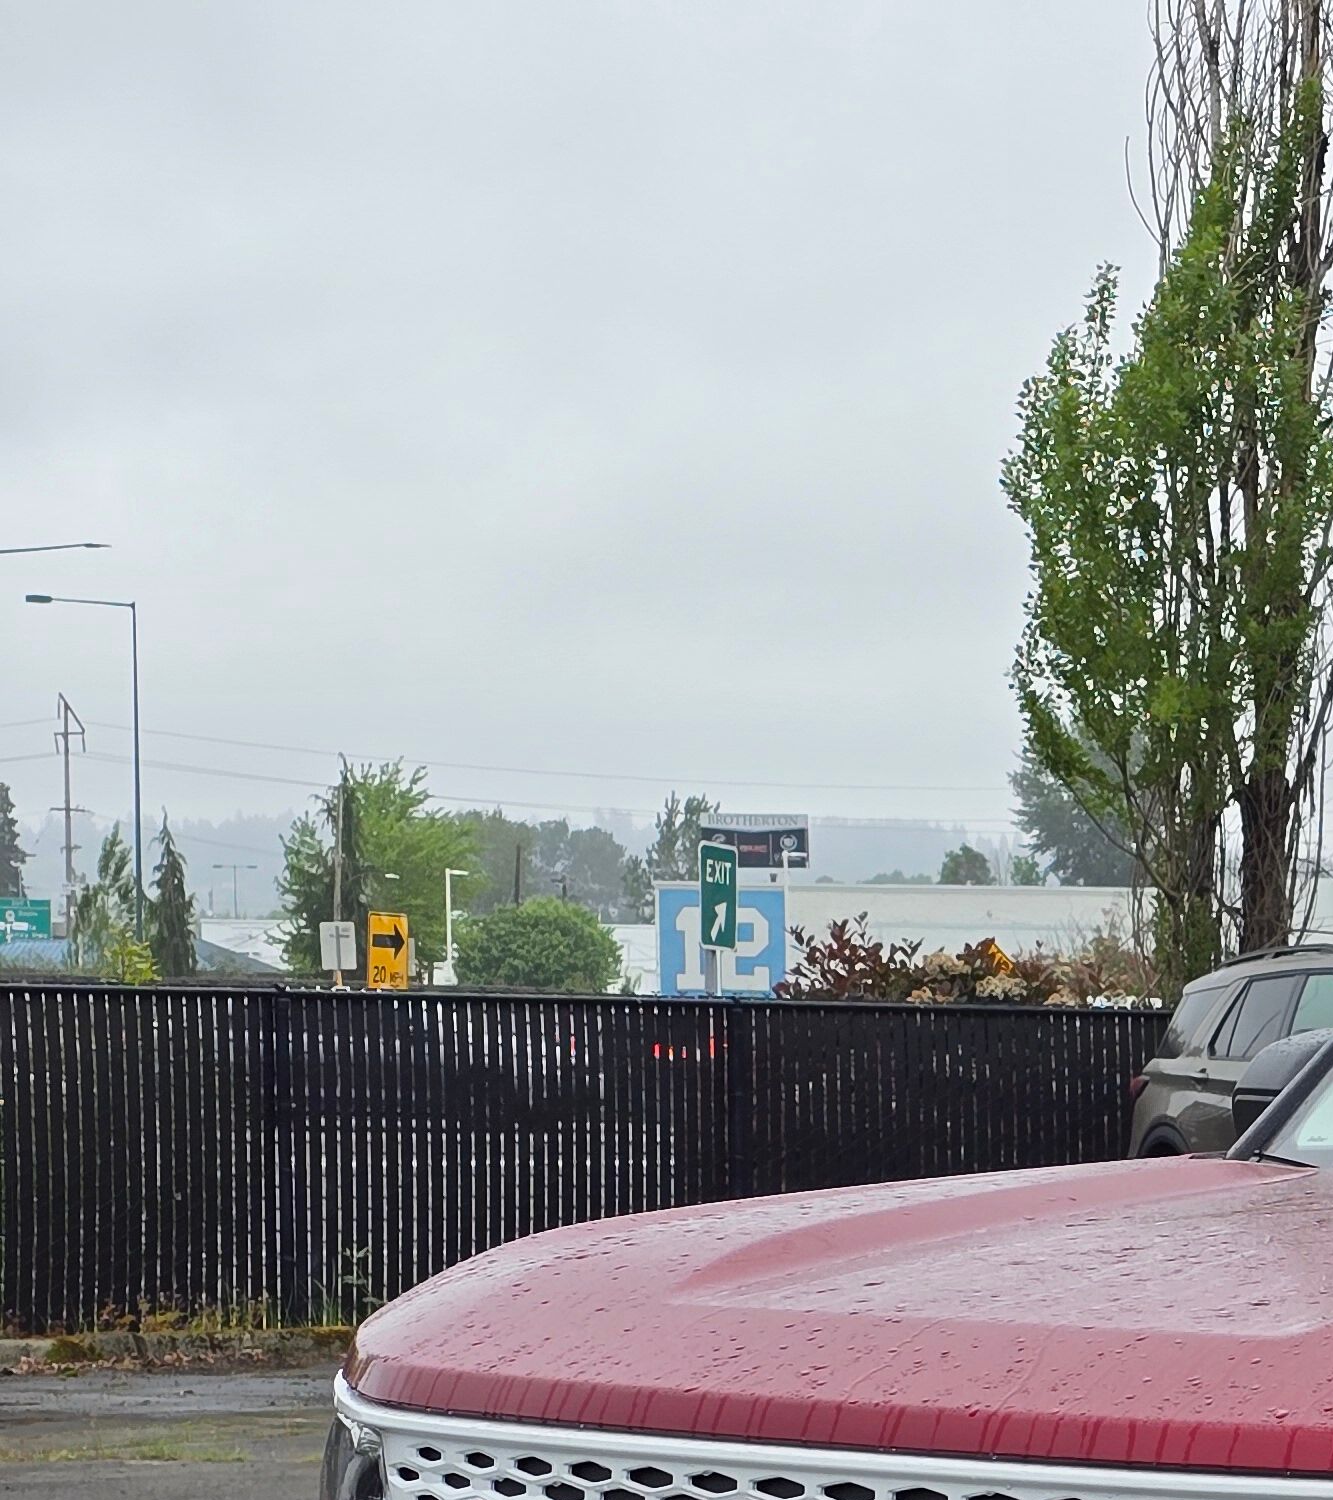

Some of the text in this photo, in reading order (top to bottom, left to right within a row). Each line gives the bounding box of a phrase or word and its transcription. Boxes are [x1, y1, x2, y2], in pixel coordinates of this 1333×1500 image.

[707, 813, 799, 827] BROTHERTON
[706, 858, 732, 886] EXIT
[372, 965, 387, 984] 20
